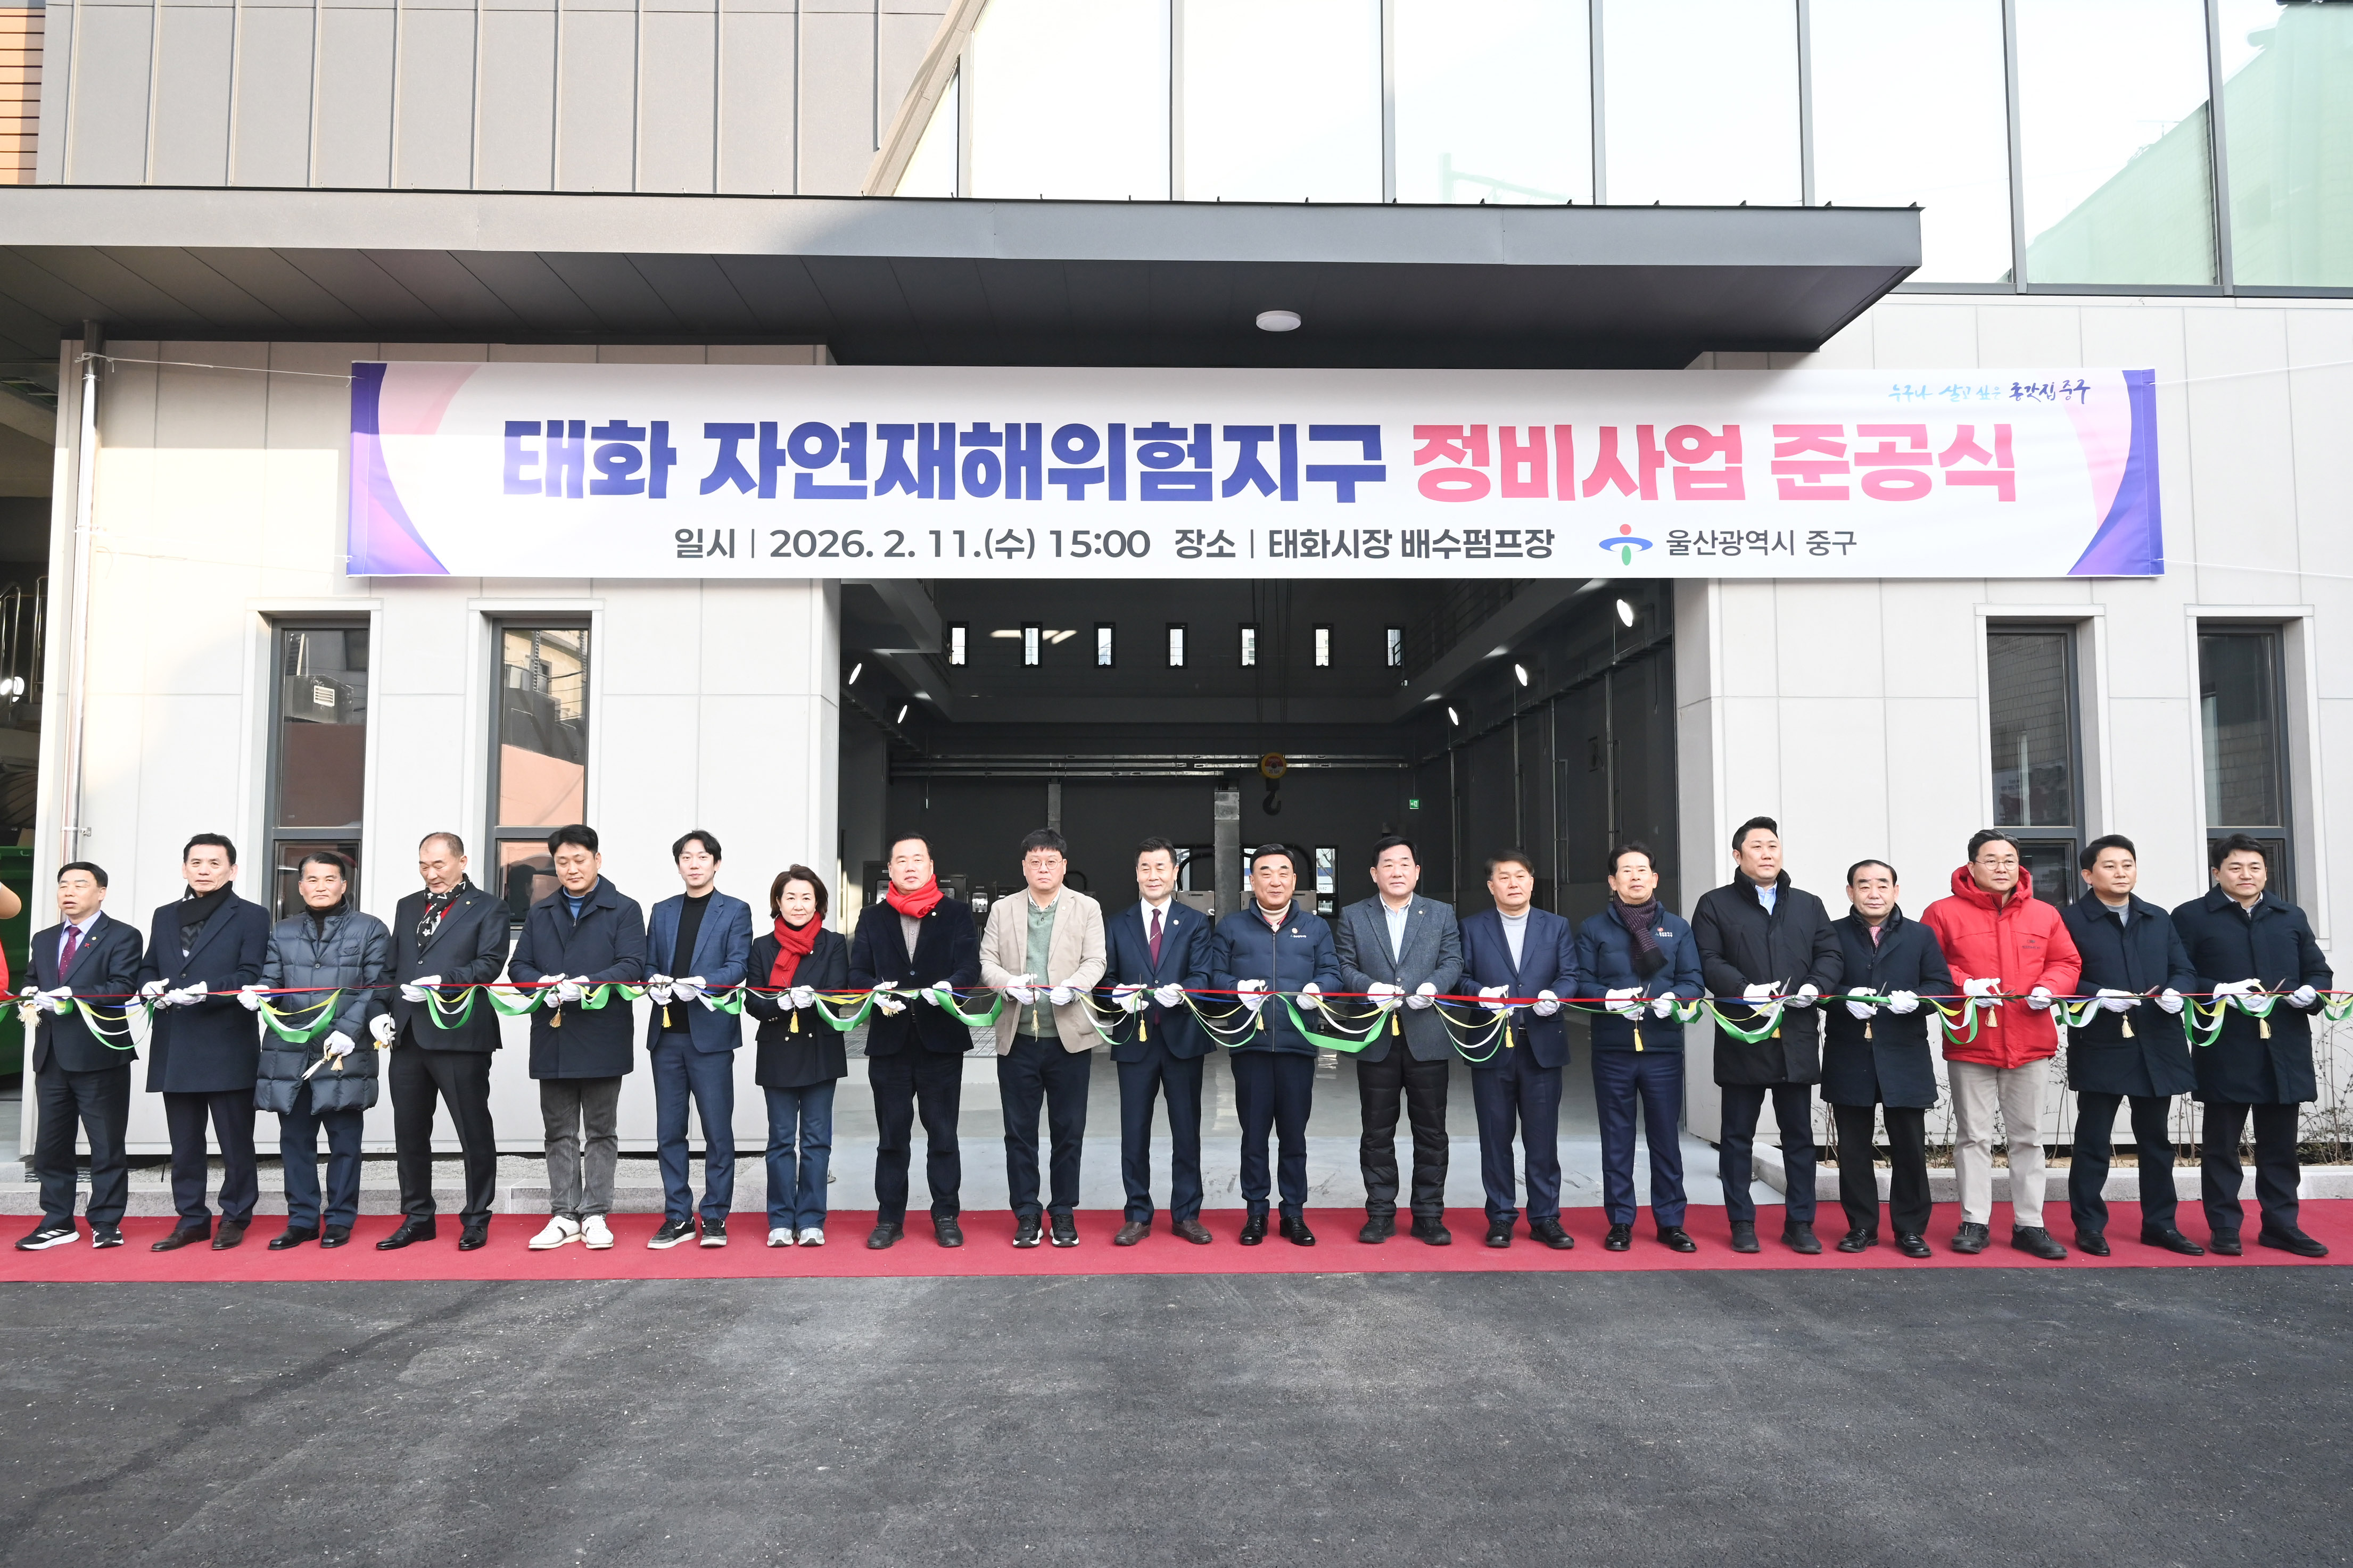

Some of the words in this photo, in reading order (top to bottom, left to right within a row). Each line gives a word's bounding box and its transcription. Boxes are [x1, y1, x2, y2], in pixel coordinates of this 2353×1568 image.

[1888, 384, 1933, 402] 누구나
[1938, 384, 1971, 402] 살고
[2059, 379, 2091, 404] 중구
[504, 420, 677, 499] 태화
[700, 421, 1386, 503] 자연재해위험지구
[1413, 424, 1745, 502] 정비사업
[1771, 424, 2016, 502] 준공식
[675, 529, 734, 558] 일시
[770, 530, 873, 557] 2026.
[884, 530, 915, 557] 2.
[929, 528, 1035, 559] 11.(수)
[1050, 530, 1150, 558] 15:00
[1175, 529, 1235, 559] 장소
[1269, 529, 1392, 559] 태화시장
[1401, 529, 1555, 559] 배수펌프장
[1666, 530, 1794, 556] 울산광역시
[1806, 531, 1856, 556] 중구
